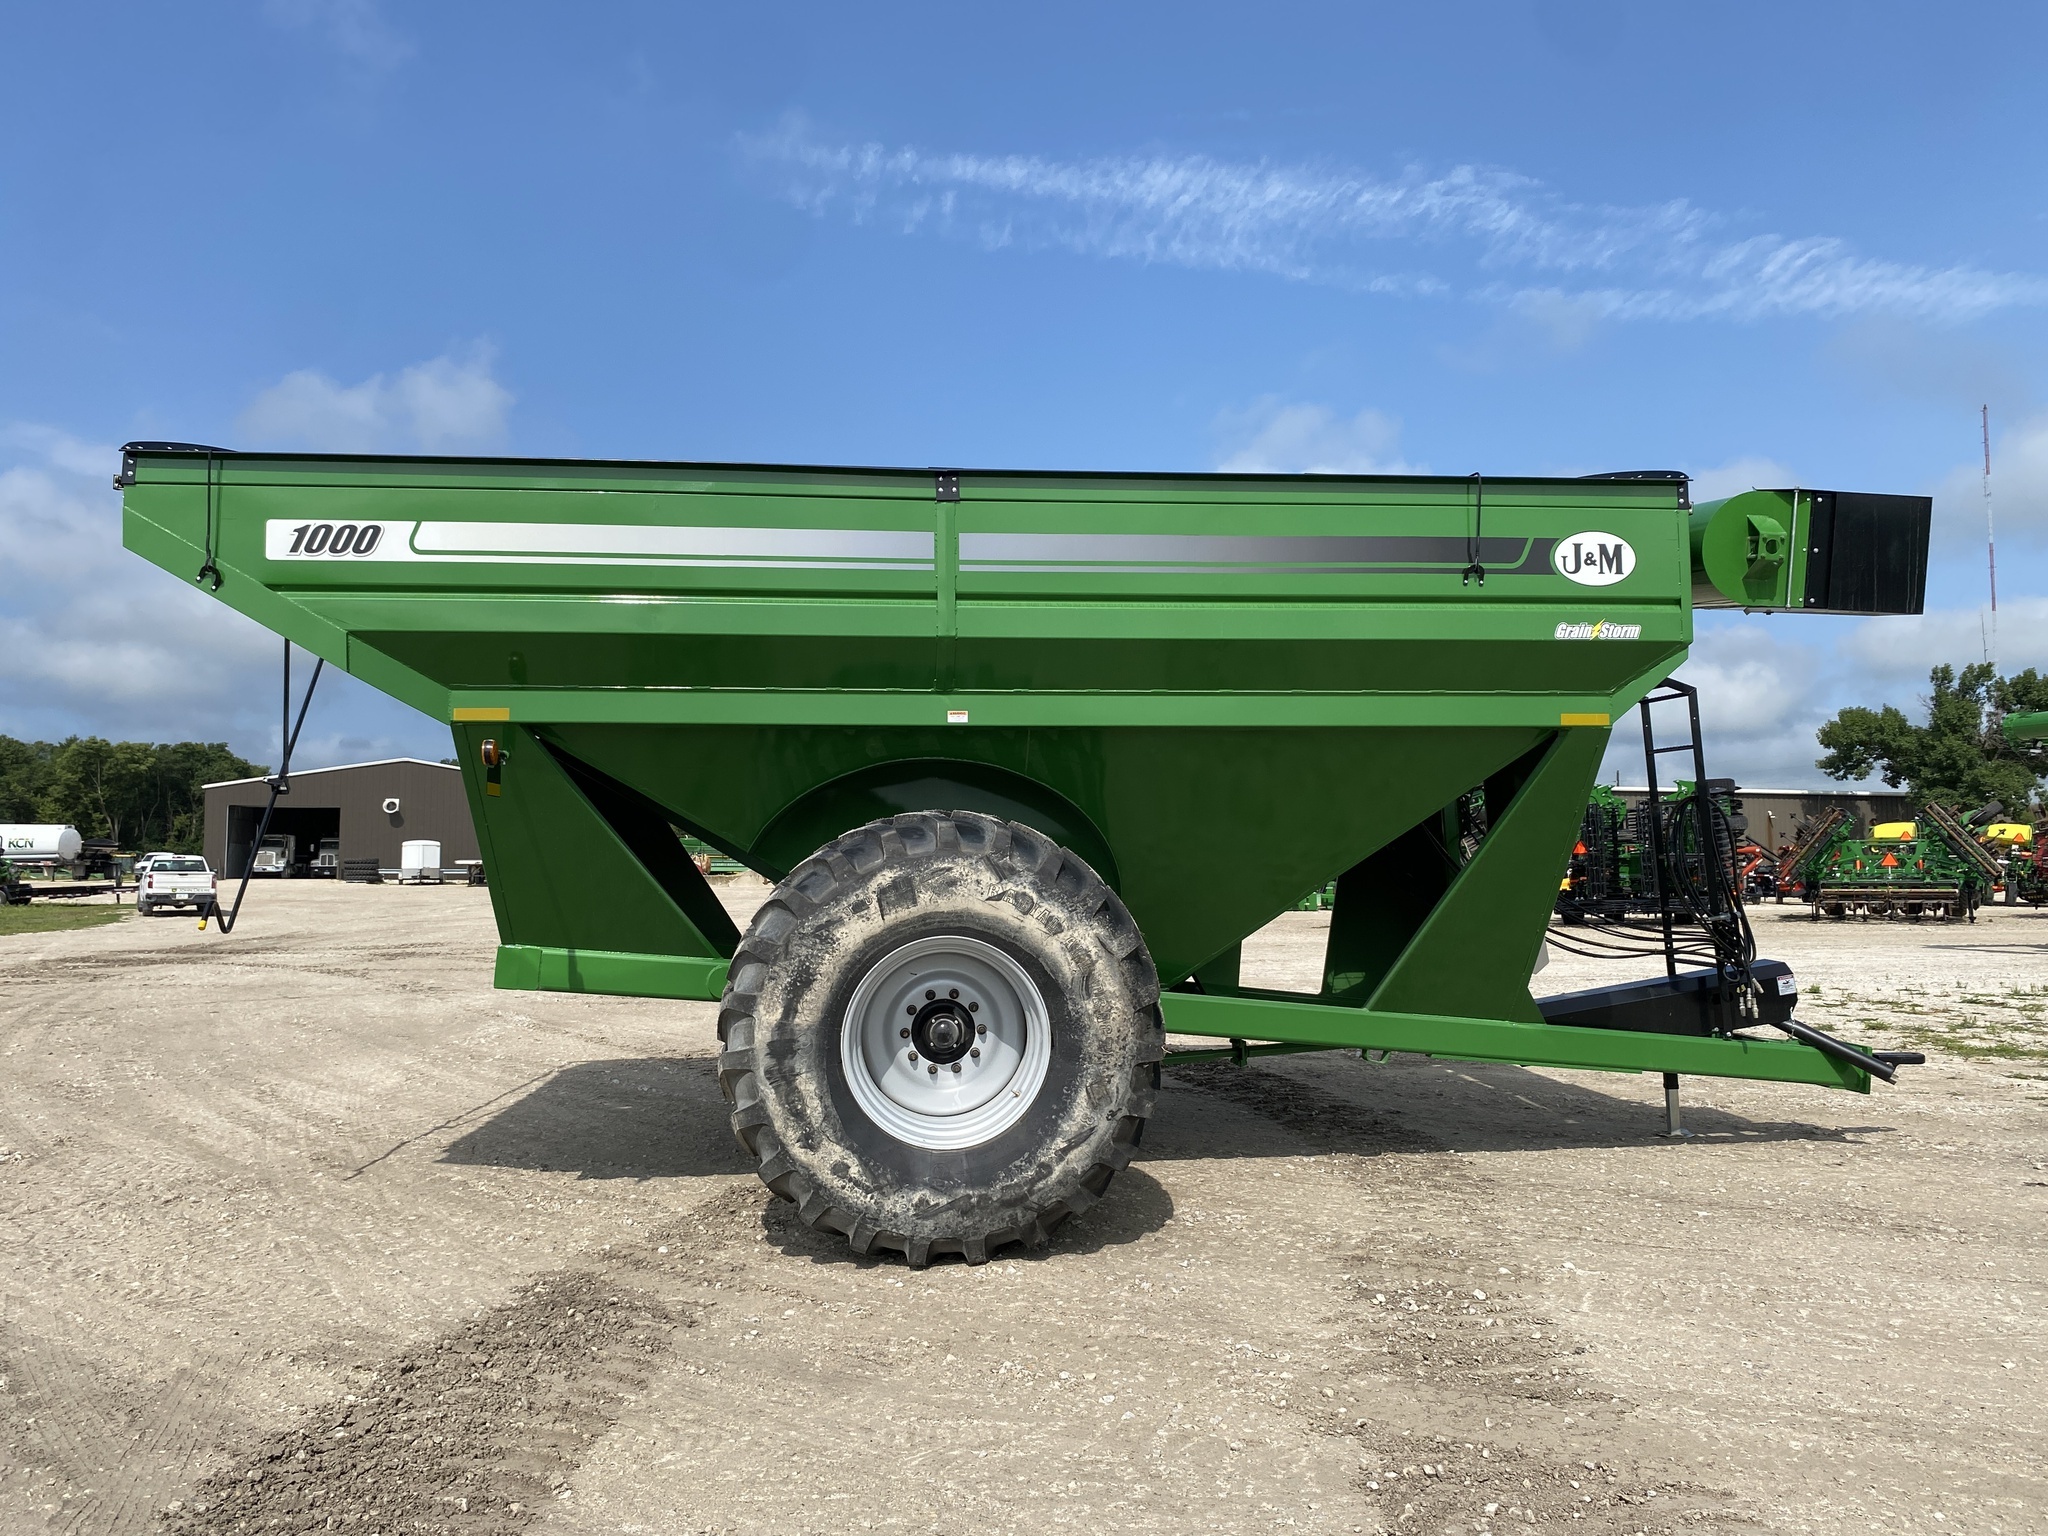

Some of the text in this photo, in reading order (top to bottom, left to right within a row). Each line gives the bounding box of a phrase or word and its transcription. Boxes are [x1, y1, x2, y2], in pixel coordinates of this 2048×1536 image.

[288, 523, 384, 556] 1000
[1561, 543, 1625, 575] J&M
[8, 838, 34, 848] KCN
